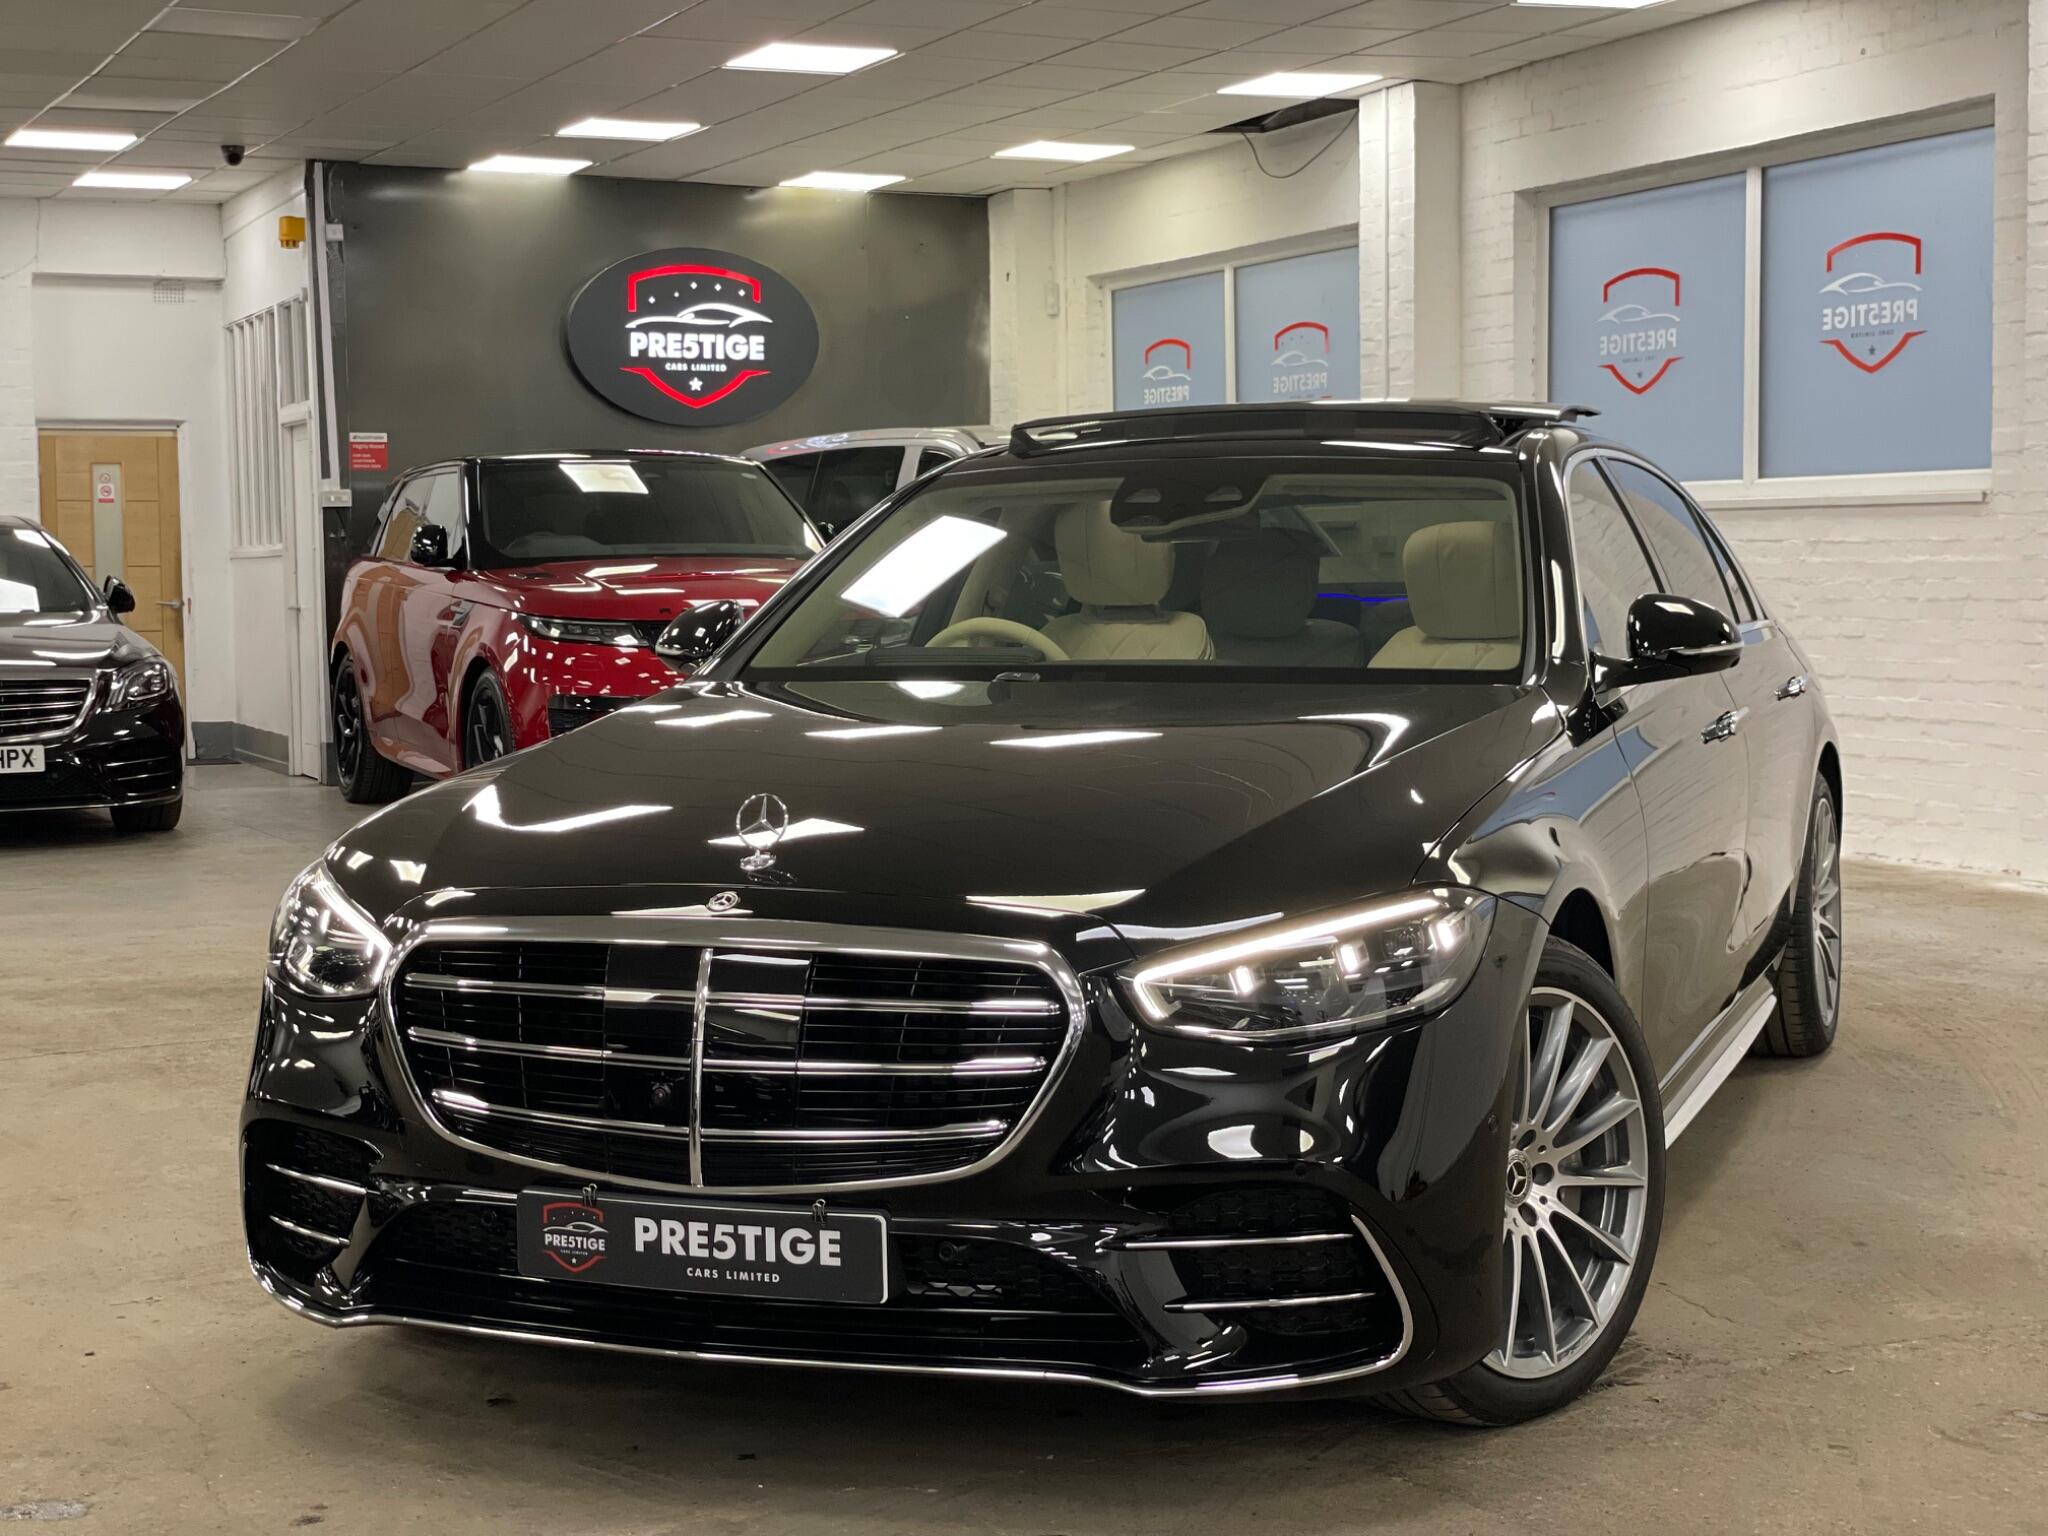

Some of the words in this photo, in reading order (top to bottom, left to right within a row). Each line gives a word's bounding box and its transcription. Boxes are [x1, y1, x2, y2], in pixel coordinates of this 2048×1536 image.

[630, 332, 765, 361] PRE5TIGE
[665, 362, 688, 371] CARS
[691, 363, 727, 372] LIMITED
[544, 1233, 606, 1251] PRE5TIGE
[634, 1216, 841, 1267] PRE5TIGE
[686, 1267, 719, 1279] CARS
[726, 1270, 780, 1283] LIMITED
